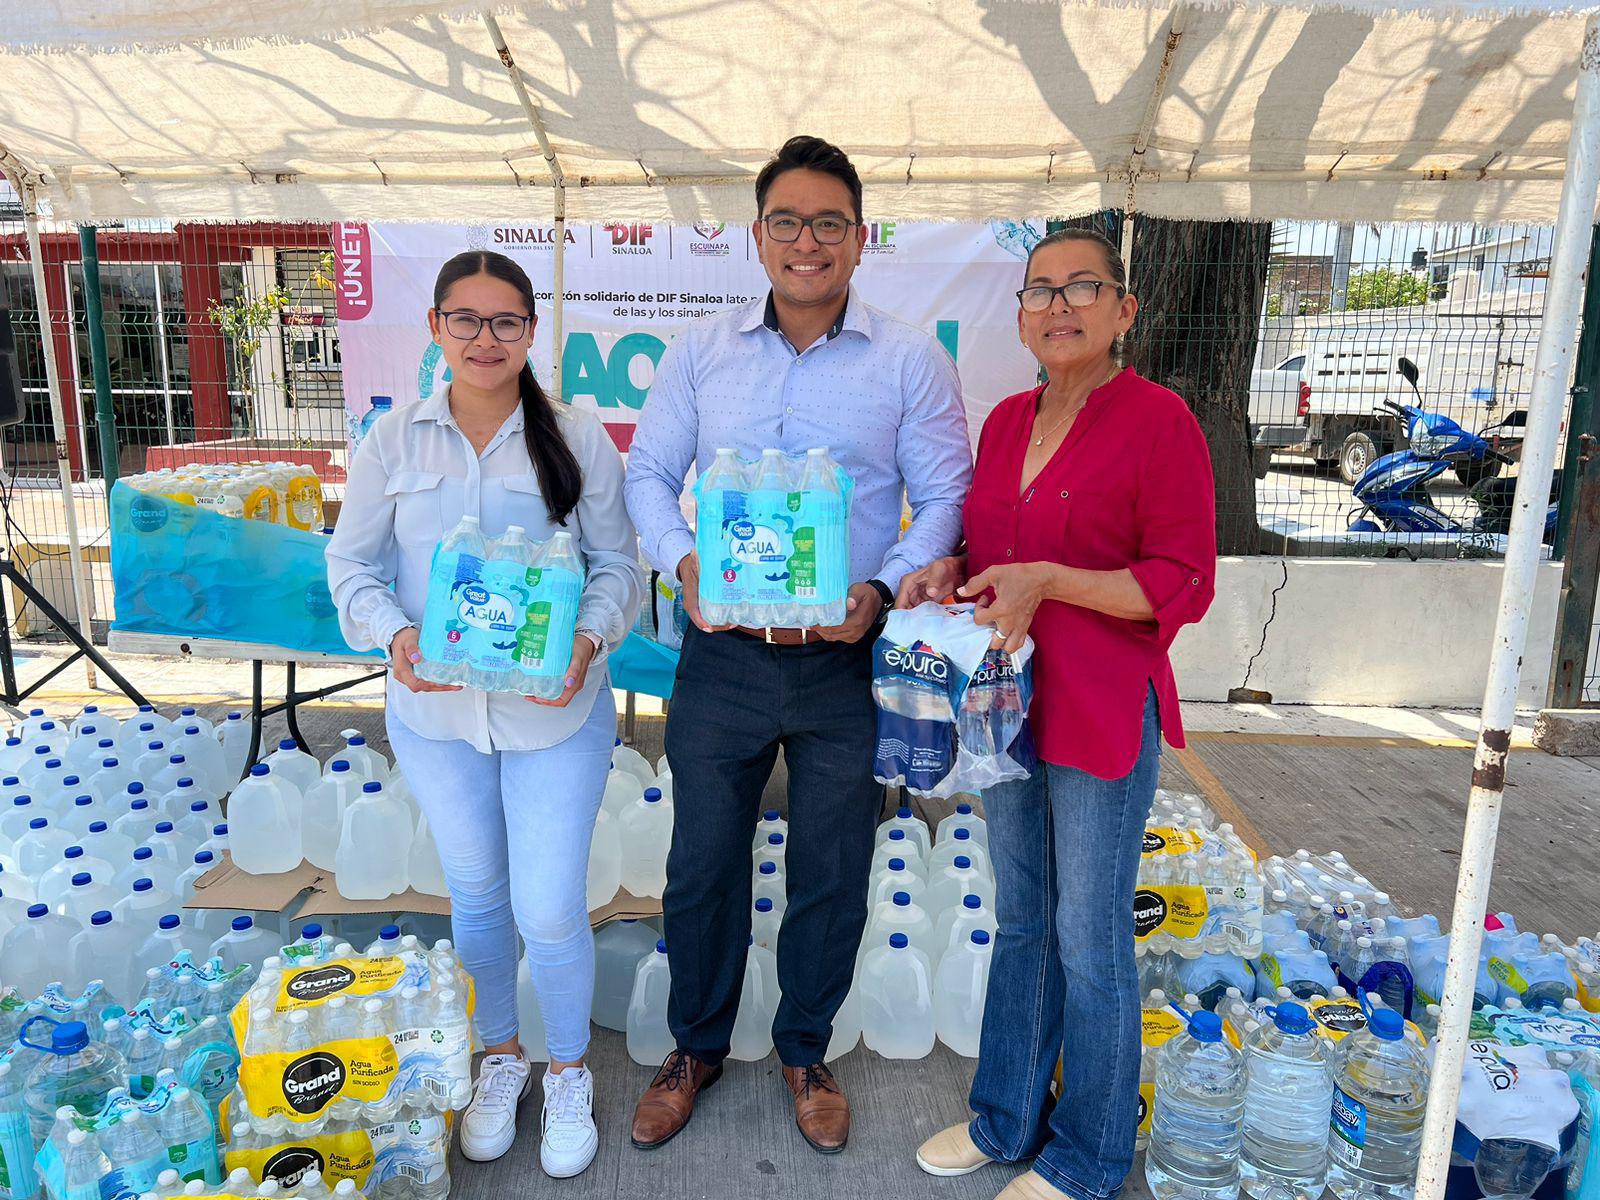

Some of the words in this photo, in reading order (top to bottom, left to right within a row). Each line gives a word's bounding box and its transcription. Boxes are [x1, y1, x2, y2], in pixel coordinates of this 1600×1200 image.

[612, 223, 652, 245] DIF
[871, 222, 896, 243] IF
[612, 247, 652, 255] SINALOA
[584, 291, 635, 302] solidario
[638, 293, 653, 302] de
[657, 293, 677, 303] DIF
[680, 293, 723, 303] Sinaloa
[726, 294, 748, 304] late
[613, 307, 628, 317] de
[631, 307, 646, 317] las
[649, 310, 657, 318] y
[659, 307, 674, 318] los
[737, 542, 775, 554] AGUA
[465, 606, 507, 623] AGUA
[451, 632, 457, 640] 6
[885, 650, 948, 679] epura
[1133, 904, 1163, 920] rand
[291, 973, 351, 991] Grand
[1528, 1023, 1587, 1034] AGUA
[394, 1033, 403, 1044] 24
[350, 1060, 372, 1070] Agua
[351, 1065, 394, 1077] Purificada
[285, 1067, 341, 1094] Grand
[291, 1083, 337, 1105] Brand
[370, 1129, 379, 1140] 24
[329, 1153, 350, 1163] Agua
[329, 1158, 371, 1171] Purificada
